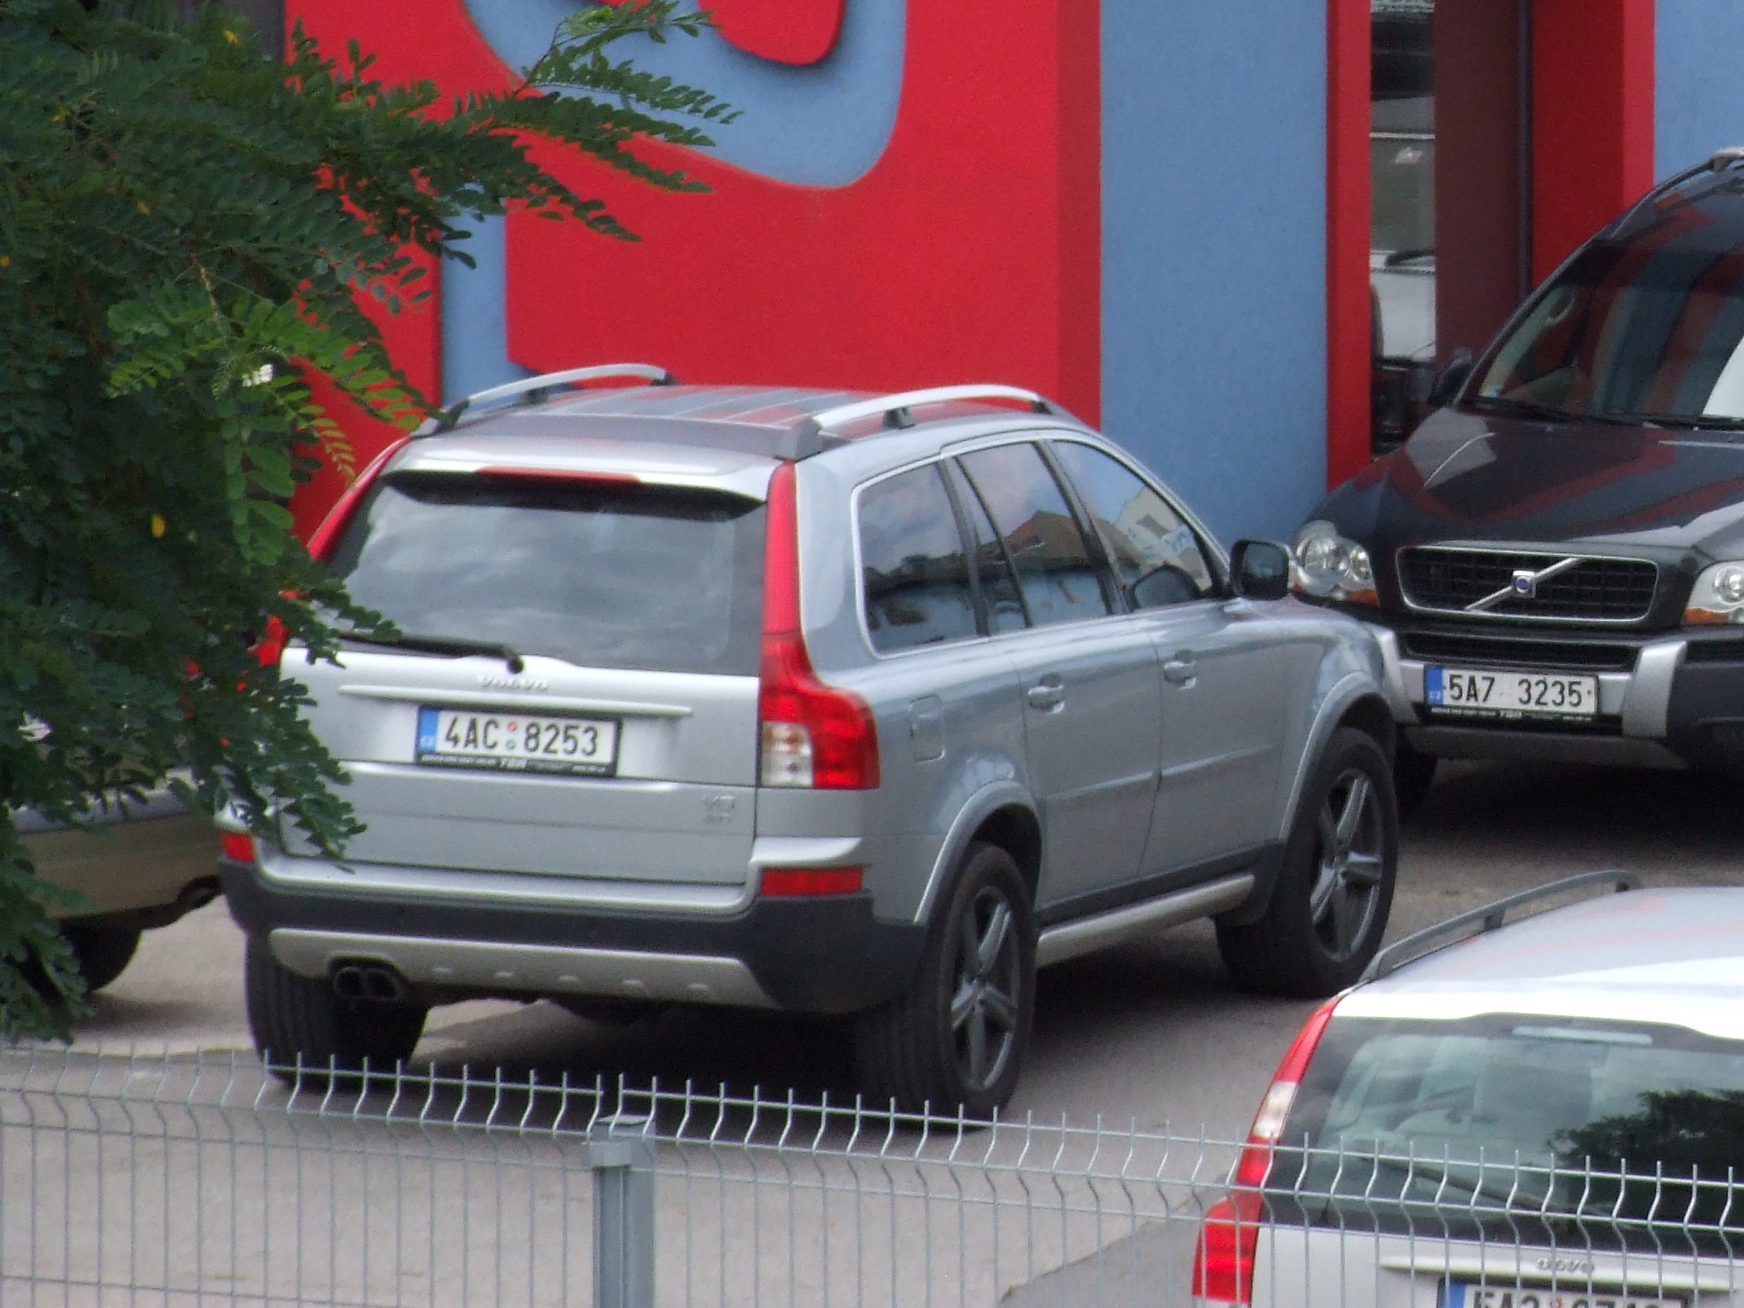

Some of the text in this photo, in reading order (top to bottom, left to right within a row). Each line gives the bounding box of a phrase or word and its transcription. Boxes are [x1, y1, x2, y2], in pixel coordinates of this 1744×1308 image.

[1449, 674, 1583, 707] 5A7 3235
[445, 716, 599, 757] 4AC 8253
